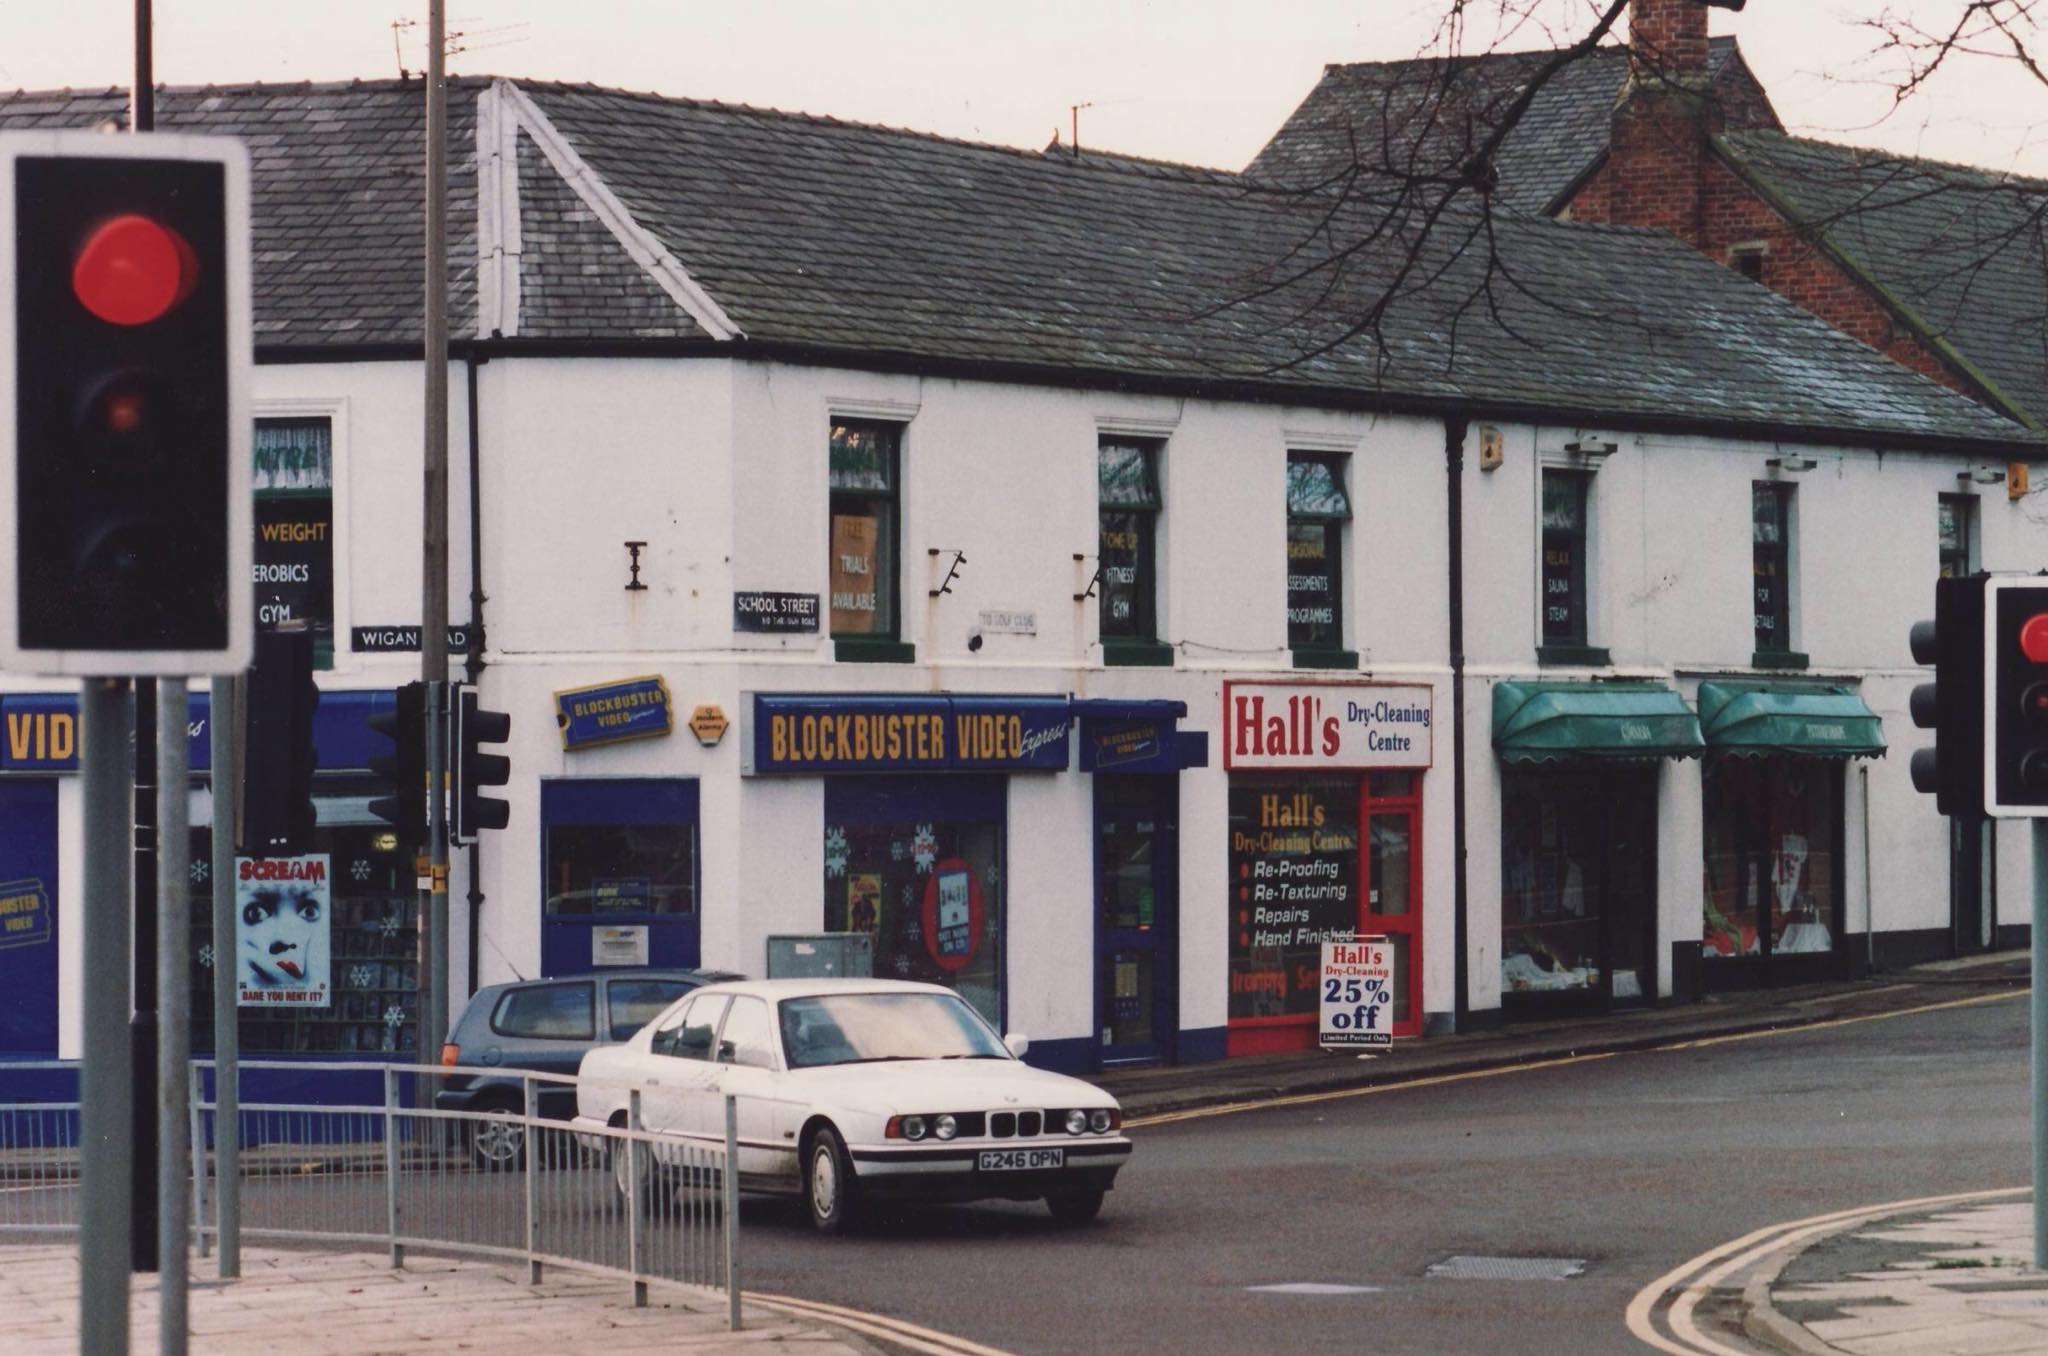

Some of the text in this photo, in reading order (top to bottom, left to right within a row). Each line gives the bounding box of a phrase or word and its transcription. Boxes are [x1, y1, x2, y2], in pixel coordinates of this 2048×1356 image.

[262, 522, 328, 541] WEIGHT
[252, 564, 309, 583] EROBICS
[841, 555, 868, 574] TRIALS
[1107, 566, 1134, 584] FITNESS
[738, 596, 816, 614] SCHOOL STREET
[832, 592, 876, 610] AVAILABLE
[1113, 600, 1130, 618] GYM
[259, 604, 291, 623] GYM
[362, 631, 417, 646] WIGAN
[575, 690, 663, 717] BLOCKBUSTER
[598, 711, 631, 728] VIDEO
[1347, 701, 1430, 727] Dry-Cleaning
[1235, 696, 1340, 757] Hall's
[8, 713, 86, 760] VID
[772, 714, 1067, 761] BLOCKBUSTER VIDEO Express
[1368, 730, 1411, 751] Centre
[1261, 794, 1325, 827] Hall's
[1234, 831, 1350, 855] Dry-Cleaning Centre
[240, 859, 326, 885] SCREAM
[1254, 860, 1339, 878] Re-Proofing
[1254, 882, 1347, 901] Re-Texturing
[1254, 906, 1310, 926] Repairs
[1254, 925, 1355, 947] Hand Finished
[1333, 946, 1382, 965] Hall's
[1325, 966, 1389, 978] Dry-Cleaning
[267, 991, 283, 1001] YOU
[1325, 979, 1390, 1003] 25%
[1332, 1005, 1380, 1029] off
[1323, 1033, 1347, 1041] Limited
[980, 1151, 1062, 1169] G246 OPN
